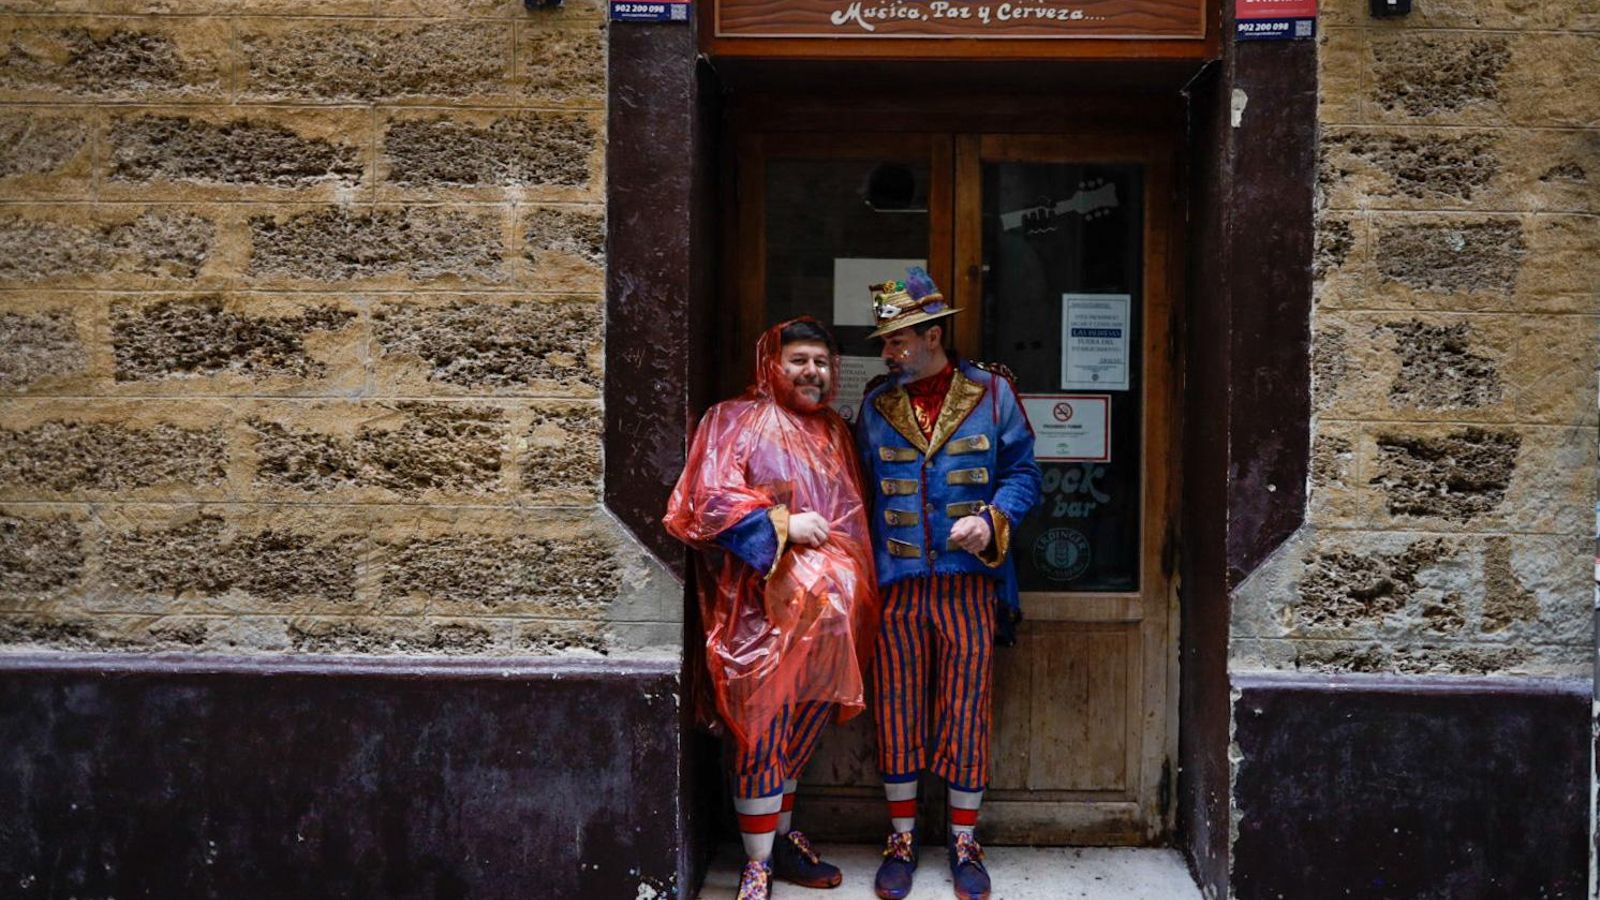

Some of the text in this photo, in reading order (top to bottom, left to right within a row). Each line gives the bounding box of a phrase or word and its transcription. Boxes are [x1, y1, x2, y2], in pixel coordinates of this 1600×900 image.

[615, 4, 665, 13] 902 200 098
[930, 1, 972, 19] Paz
[978, 6, 990, 24] y
[1238, 22, 1289, 32] 902 200 098
[1053, 494, 1096, 517] bar
